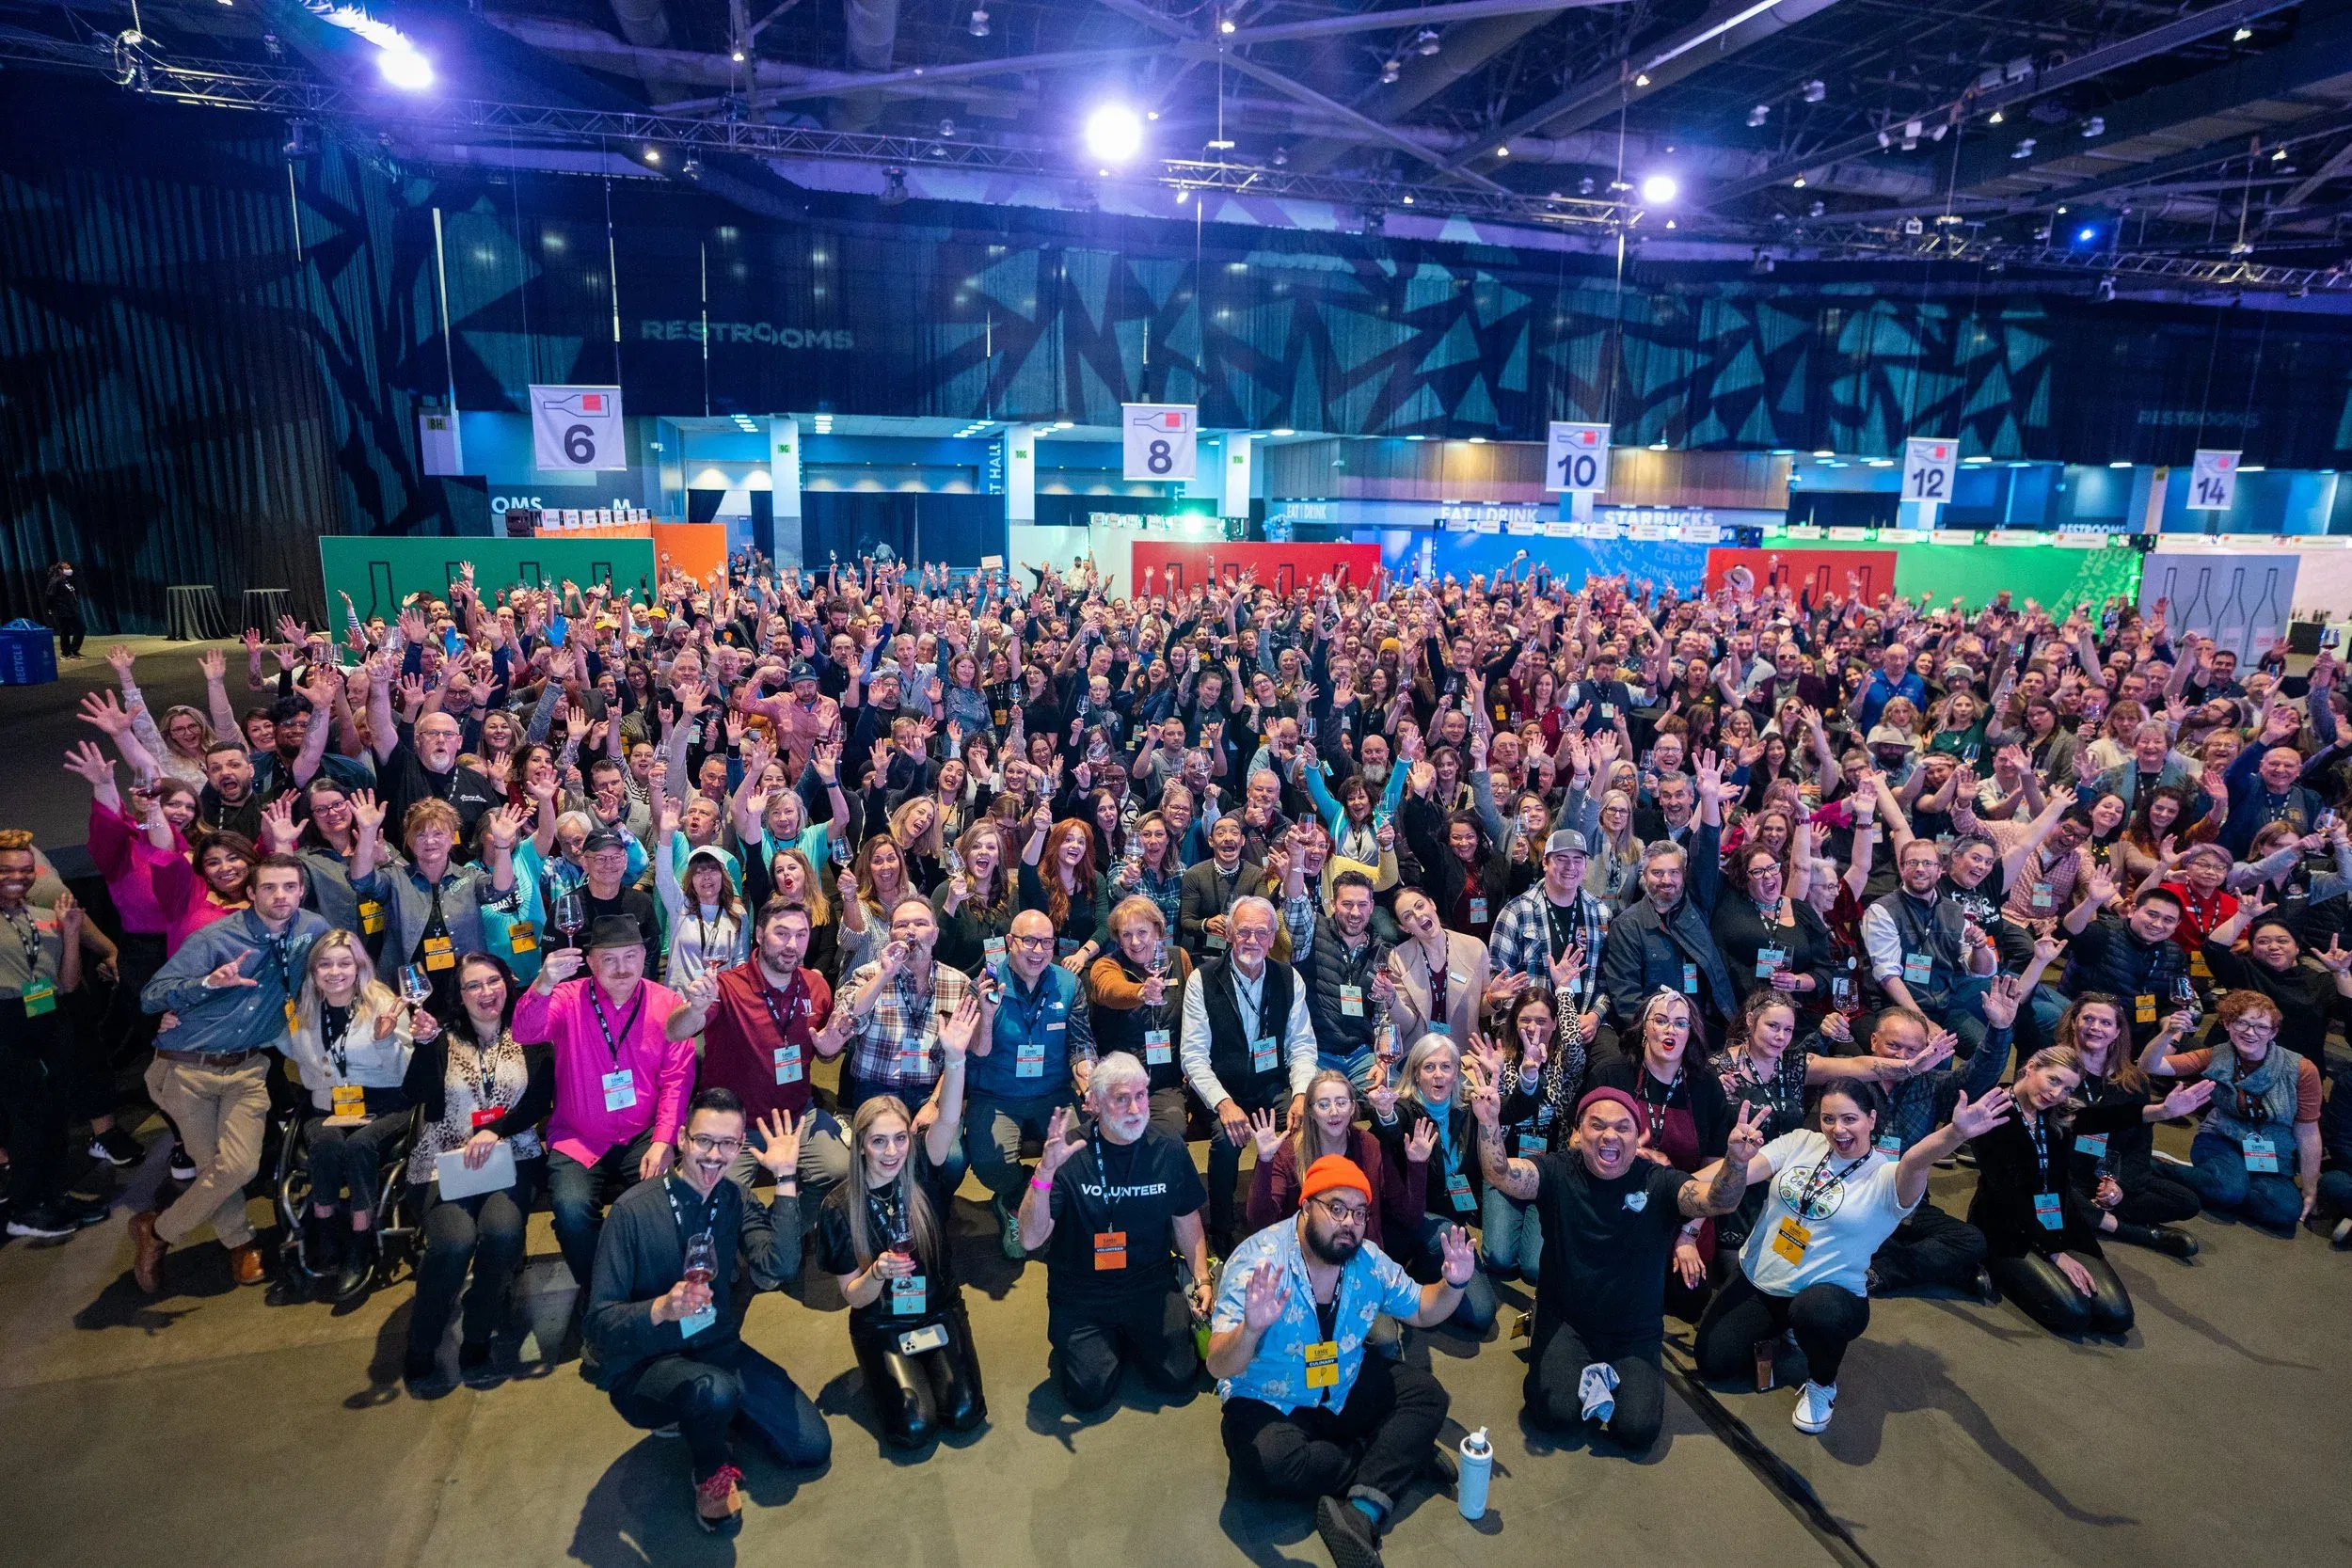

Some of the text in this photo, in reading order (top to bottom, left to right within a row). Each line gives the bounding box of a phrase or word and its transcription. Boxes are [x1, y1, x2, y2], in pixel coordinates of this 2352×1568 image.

[641, 320, 854, 349] RESTROOMS
[564, 424, 596, 464] 6
[1148, 439, 1172, 474] 8
[989, 442, 1001, 478] HALL
[1557, 454, 1597, 487] 10
[1913, 468, 1945, 498] 12
[2197, 477, 2225, 505] 14
[1287, 504, 1327, 520] EAT DRINK
[1441, 506, 1538, 523] EAT DRINK
[1604, 511, 1714, 526] STARBUCKS
[1081, 1182, 1167, 1198] VOUNTEER
